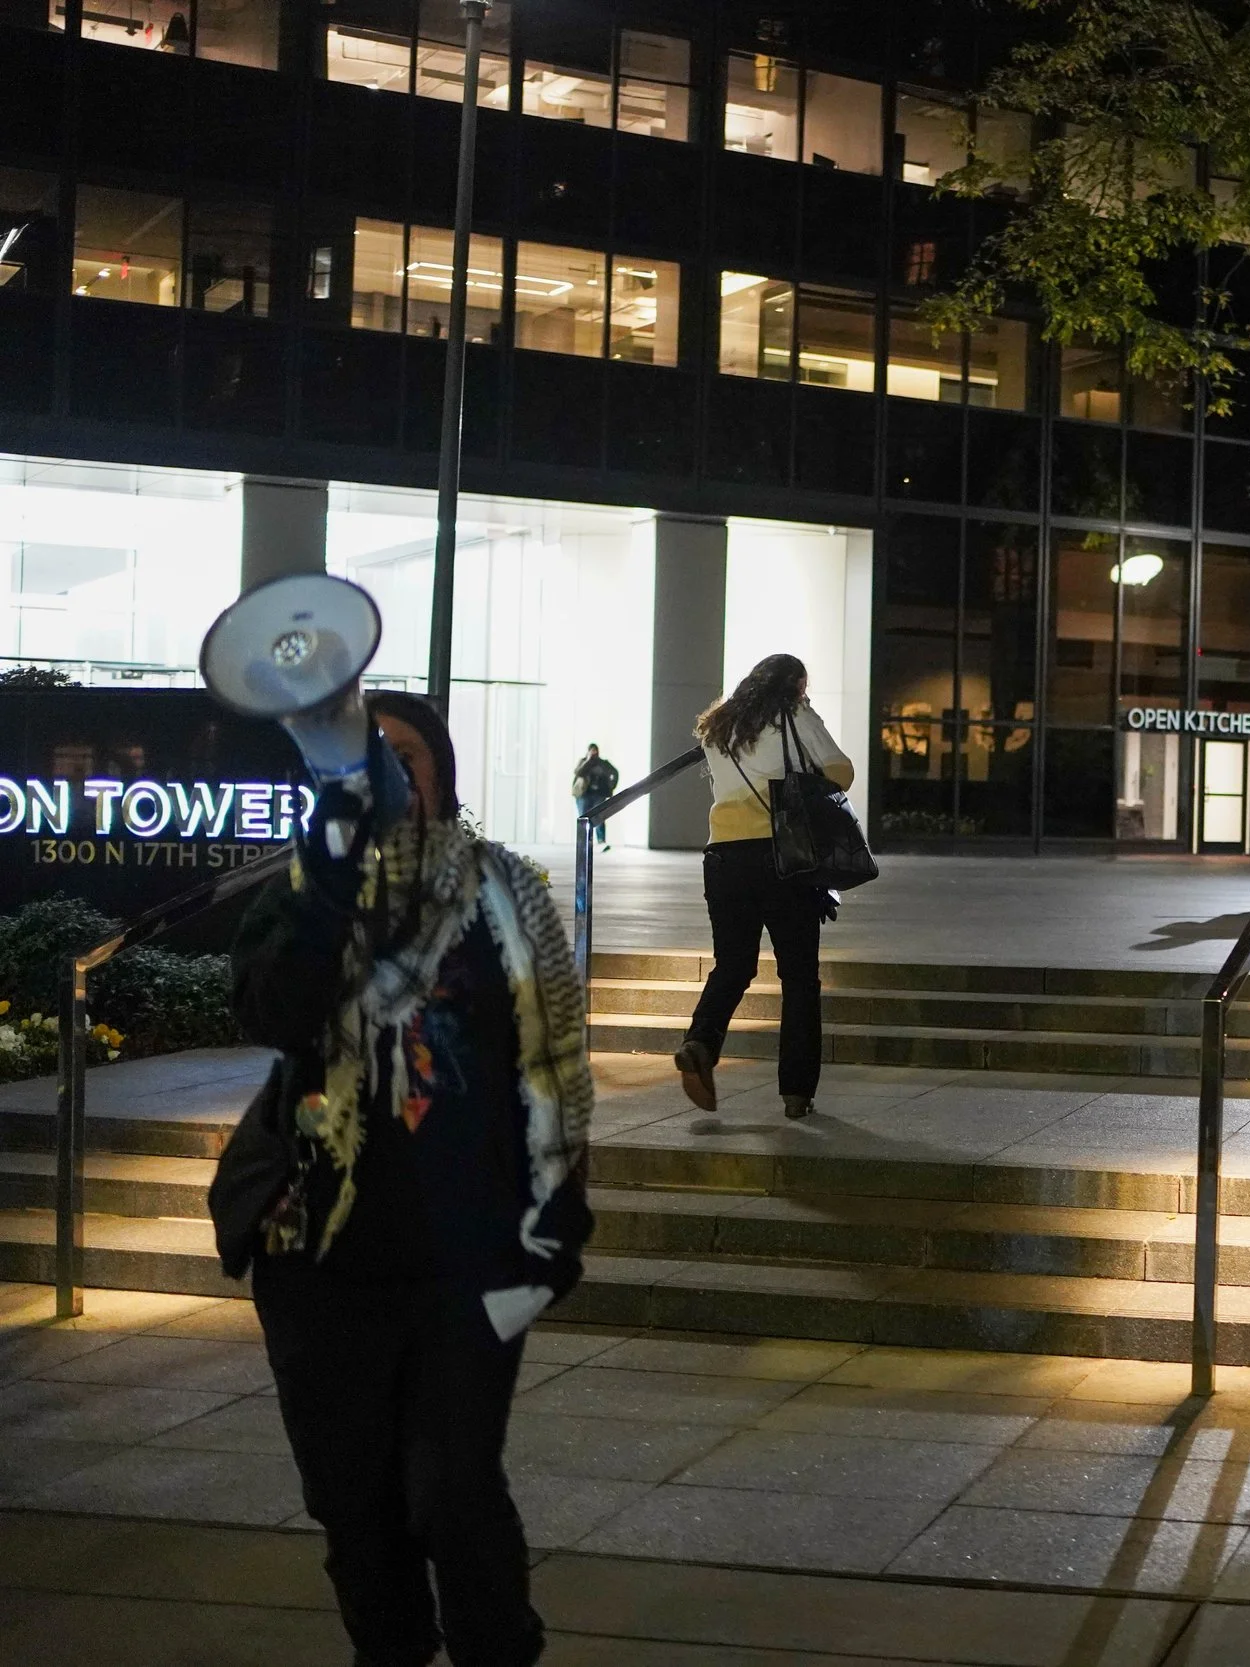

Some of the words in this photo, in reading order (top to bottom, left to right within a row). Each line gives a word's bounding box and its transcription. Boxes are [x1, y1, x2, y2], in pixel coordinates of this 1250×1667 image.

[1128, 707, 1180, 730] OPEN
[84, 780, 315, 839] TOWER
[31, 840, 95, 864] 1300
[105, 842, 124, 865] N
[134, 842, 197, 867] 17TH
